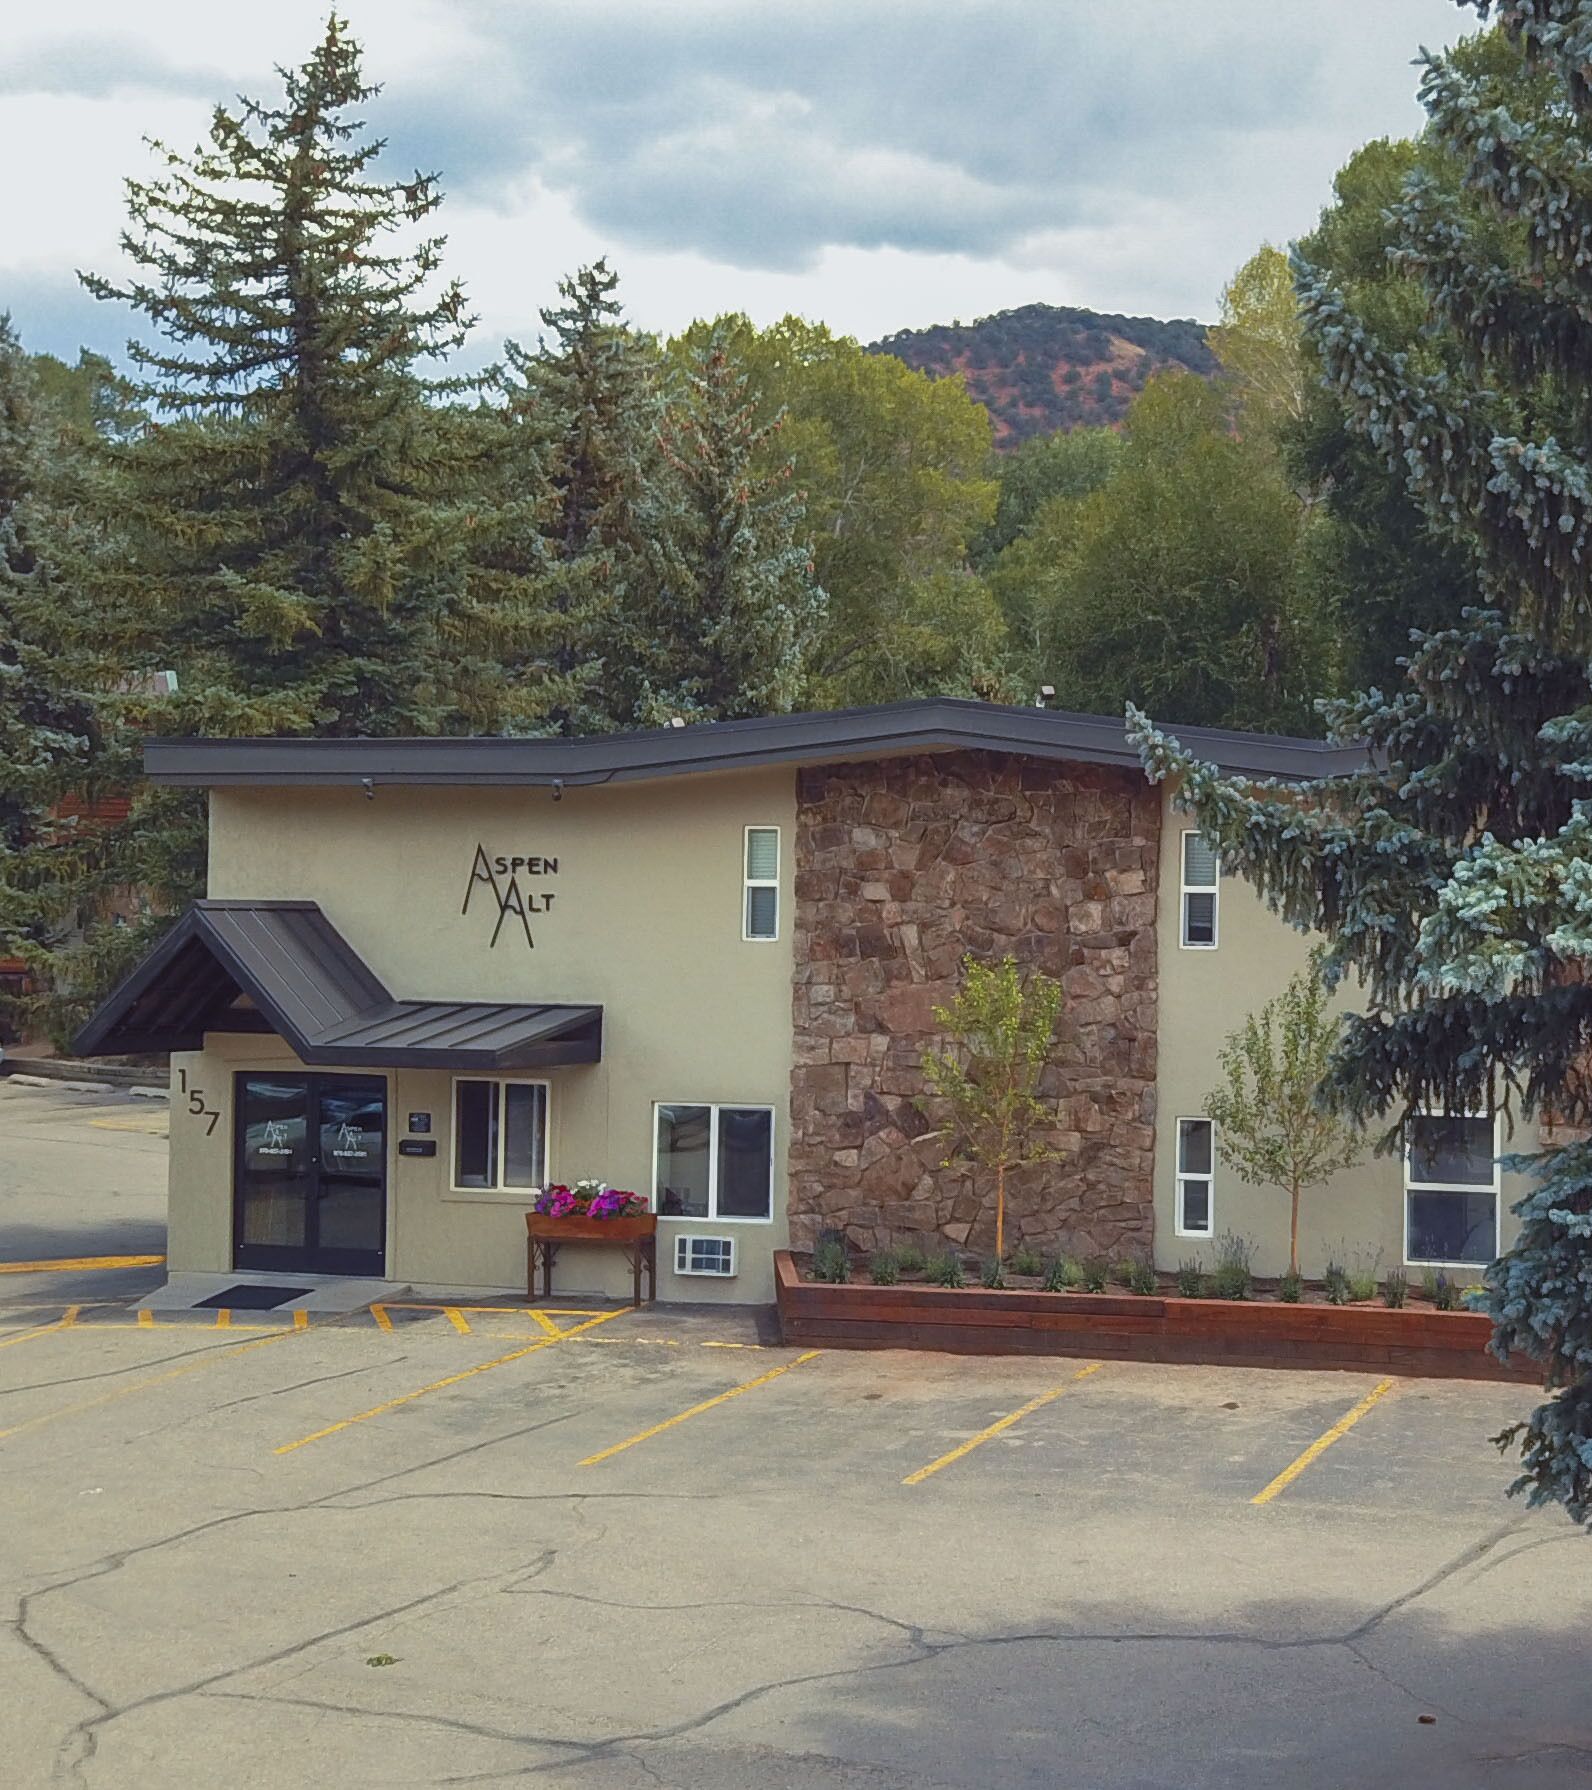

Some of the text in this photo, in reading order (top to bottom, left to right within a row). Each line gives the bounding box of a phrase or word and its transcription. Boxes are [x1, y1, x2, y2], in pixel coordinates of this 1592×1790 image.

[462, 842, 558, 914] ASPEN
[490, 875, 555, 949] ALT
[178, 1068, 220, 1136] 157
